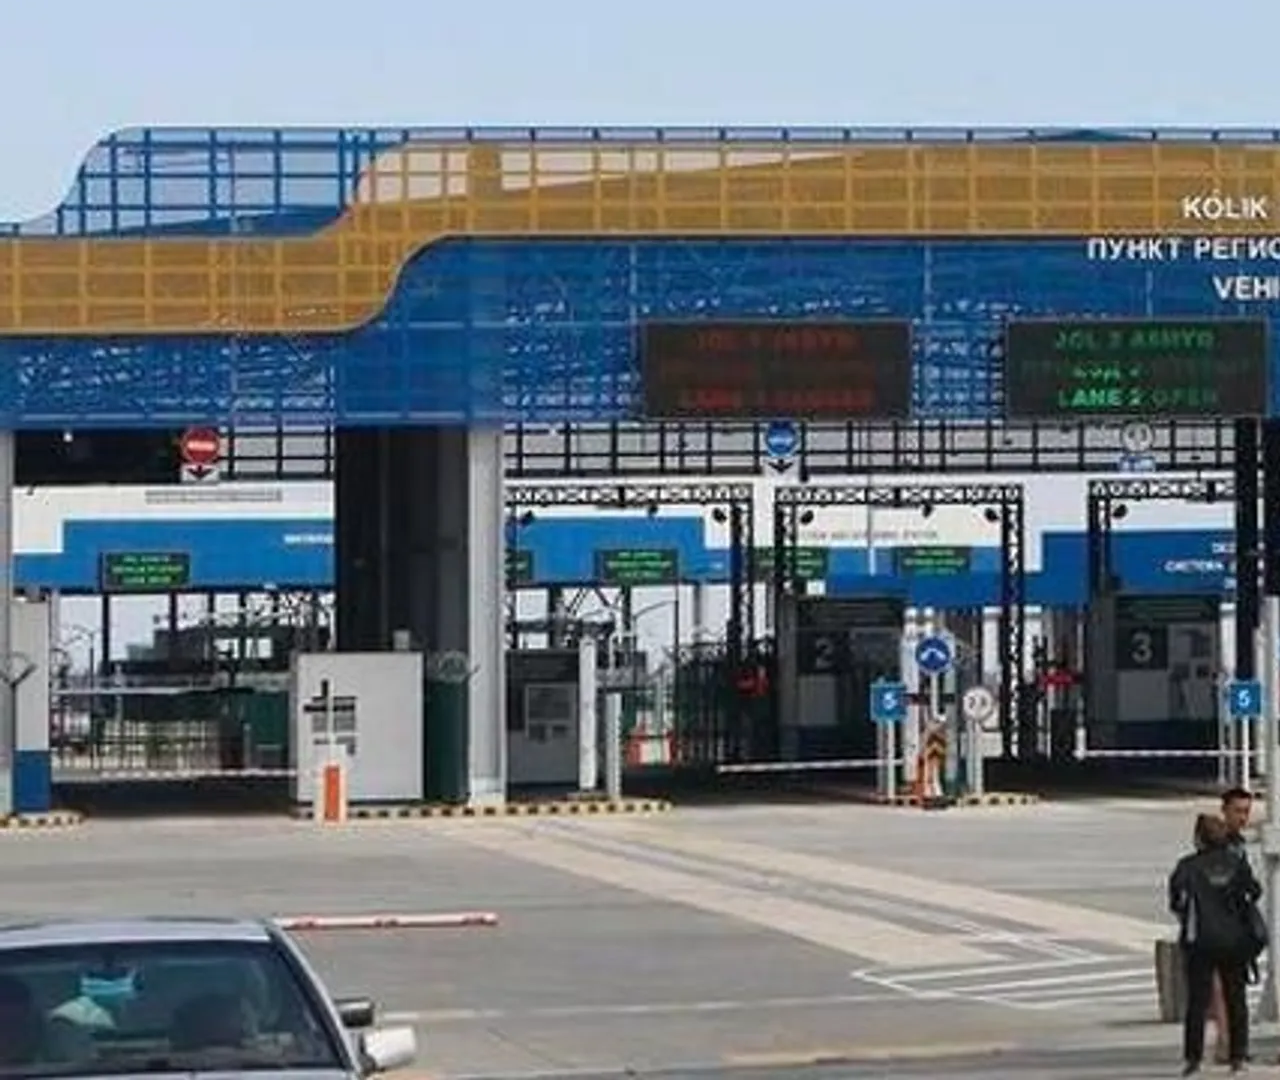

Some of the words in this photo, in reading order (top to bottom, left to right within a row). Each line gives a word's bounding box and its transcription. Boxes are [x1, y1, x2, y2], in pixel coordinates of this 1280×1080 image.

[1088, 237, 1180, 260] ПУНКТ
[815, 637, 835, 668] 2
[1131, 632, 1153, 663] 3
